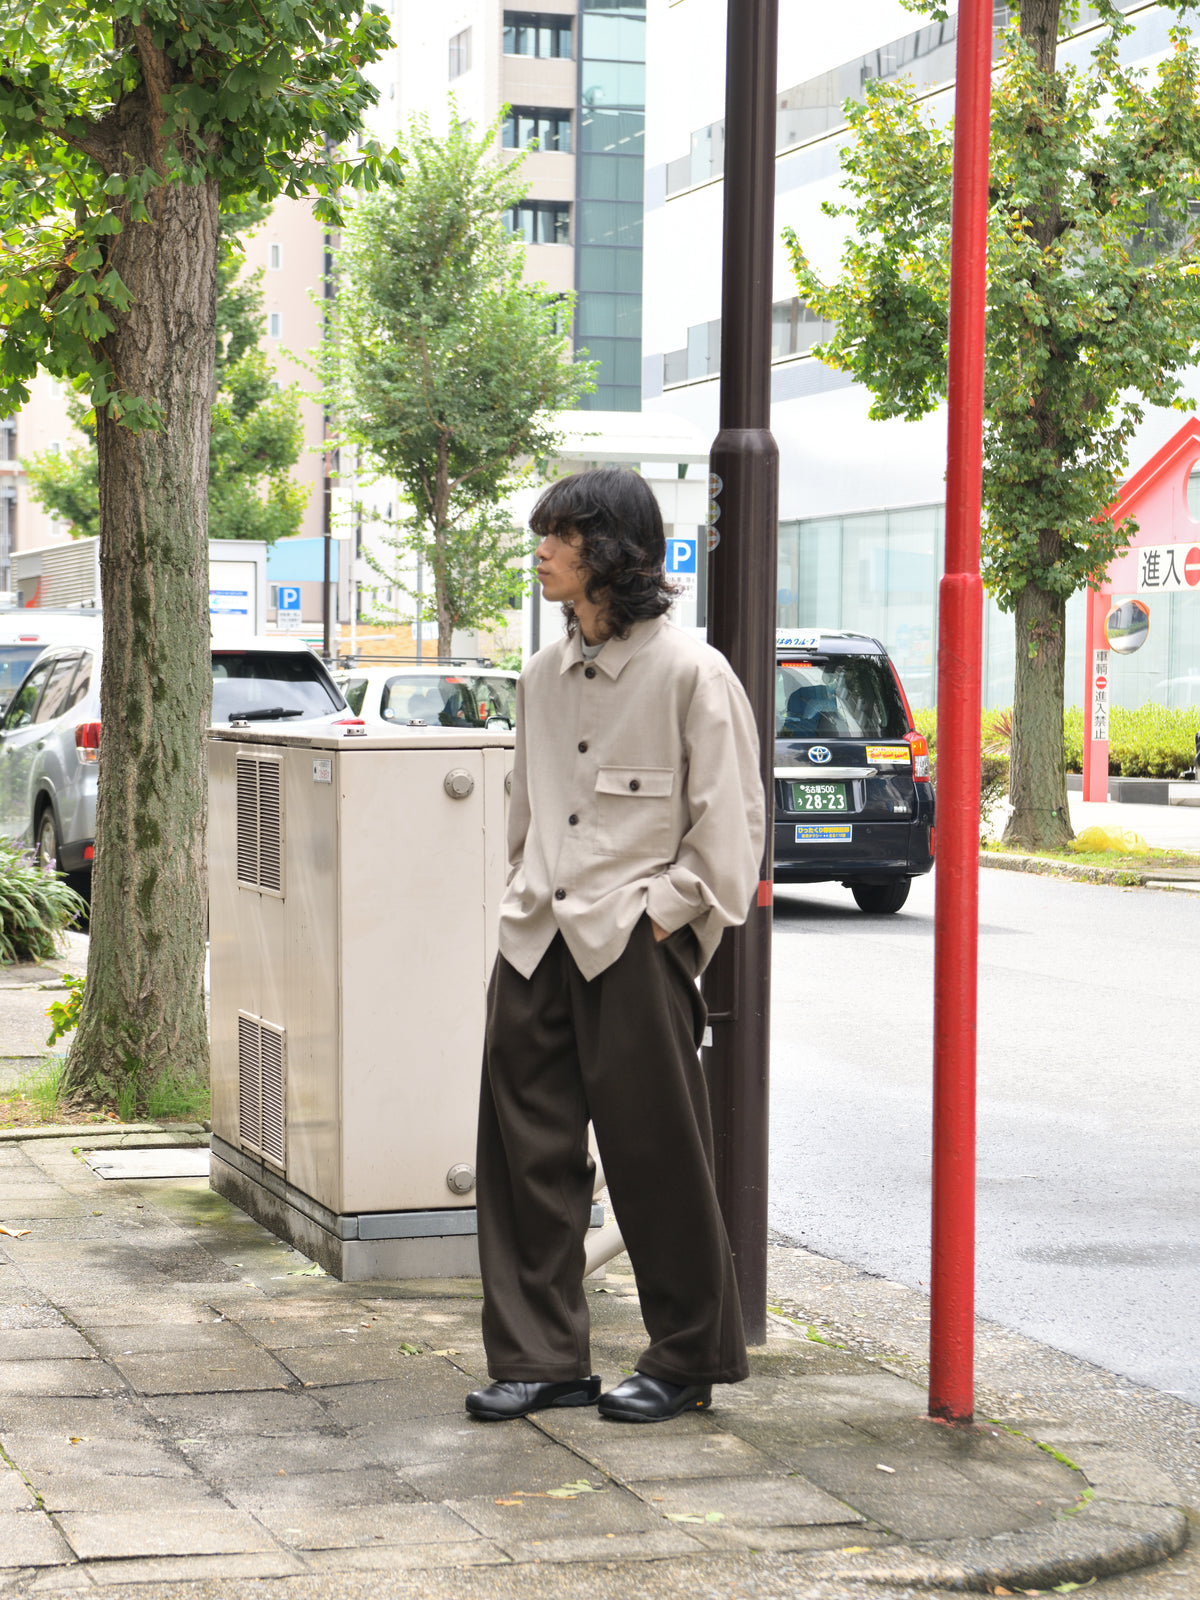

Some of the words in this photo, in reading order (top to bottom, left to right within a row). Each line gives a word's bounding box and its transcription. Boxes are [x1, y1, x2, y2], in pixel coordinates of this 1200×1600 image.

[673, 542, 691, 570] P
[1142, 550, 1181, 587] 進入
[283, 589, 297, 608] P
[1094, 691, 1106, 740] 進入禁止
[805, 794, 845, 809] 28-23
